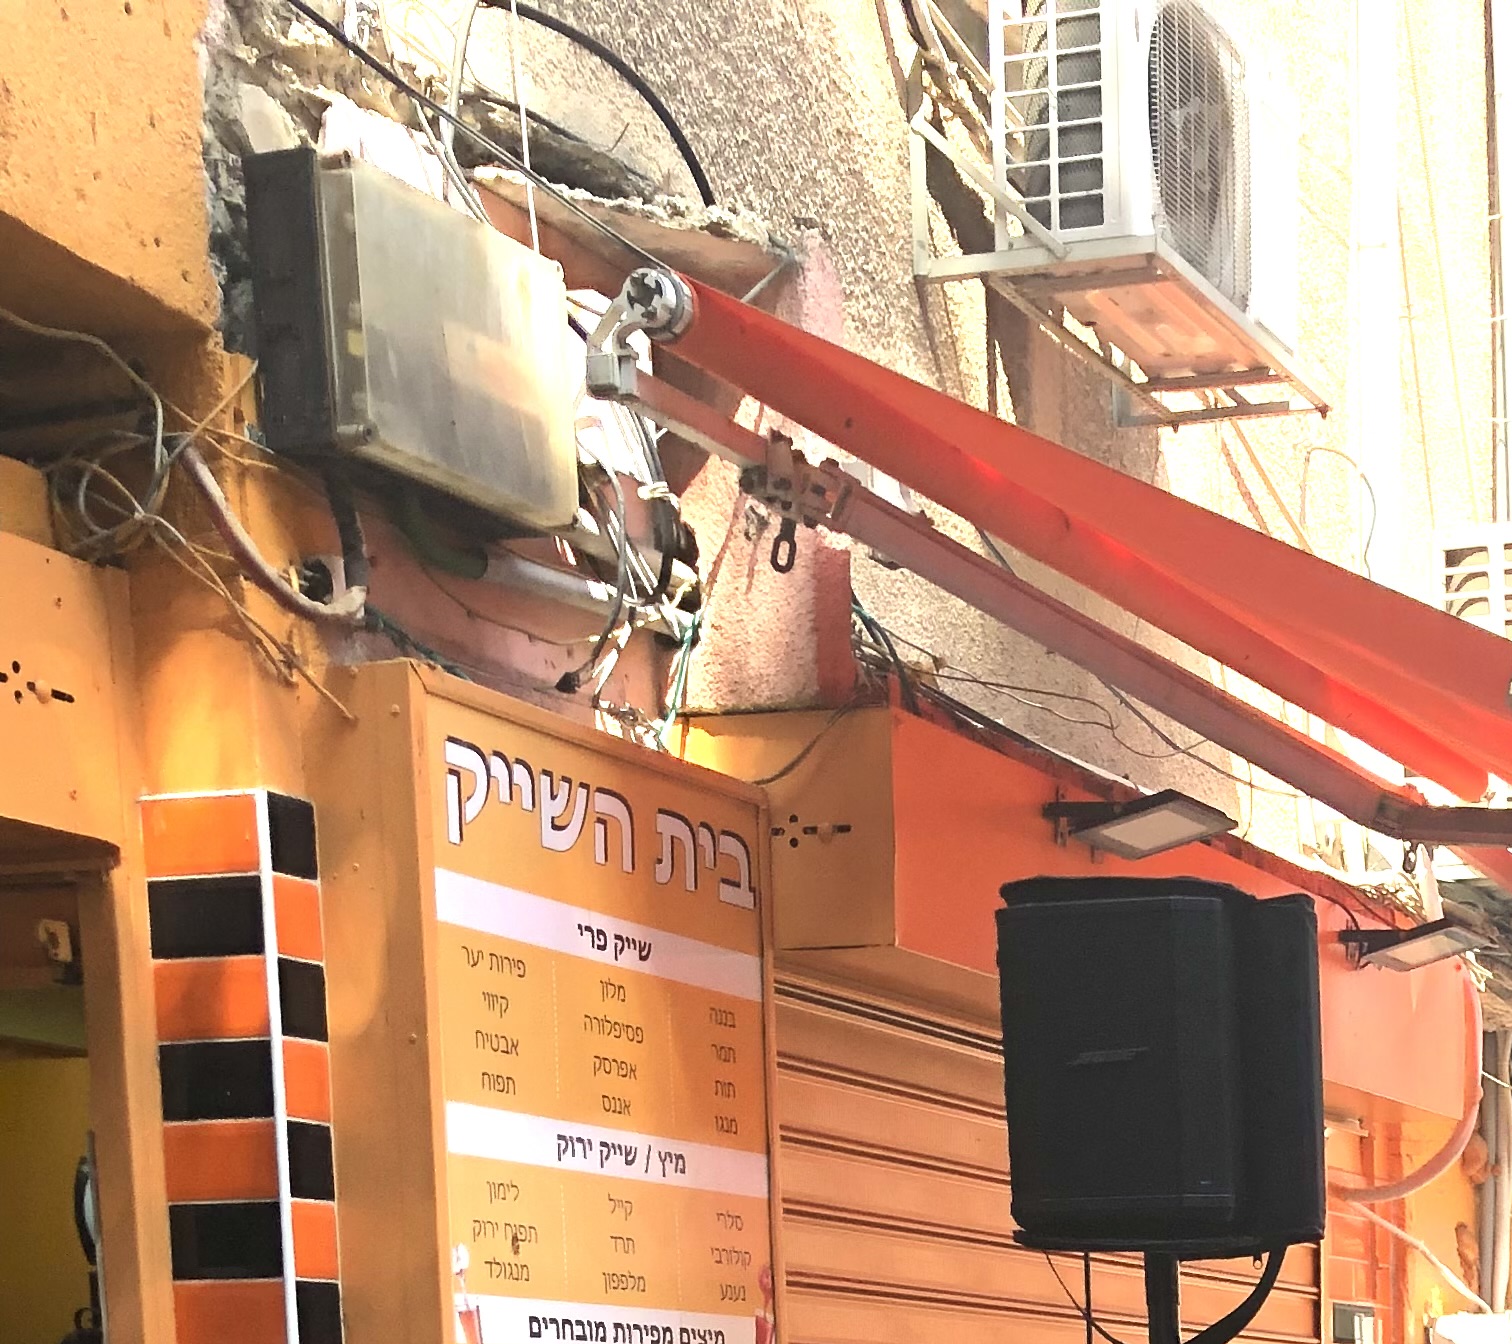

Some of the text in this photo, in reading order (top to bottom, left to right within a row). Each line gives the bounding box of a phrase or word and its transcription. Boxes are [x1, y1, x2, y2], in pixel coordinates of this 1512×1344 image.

[444, 735, 755, 909] בית השייק
[578, 923, 651, 961] שייק פרי
[461, 946, 526, 978] פירות יער
[600, 978, 626, 1002] מלון
[482, 991, 509, 1018] קיווי
[583, 1014, 644, 1044] פסיפלורה
[709, 1007, 736, 1028] בננה
[475, 1029, 519, 1056] אבטיח
[710, 1043, 736, 1063] תמר
[593, 1055, 637, 1081] אפרסק
[481, 1071, 516, 1095] תפוח
[715, 1079, 736, 1098] תות
[601, 1094, 631, 1116] אננס
[715, 1115, 738, 1135] מנגו
[556, 1133, 686, 1177] מיץ / שייק ירוק
[486, 1179, 520, 1204] לימון
[607, 1193, 633, 1221] קייל
[472, 1219, 538, 1244] תפוח ירוק
[716, 1211, 744, 1231] סלרי
[610, 1234, 635, 1254] תרד
[484, 1257, 530, 1282] מנגולד
[711, 1245, 751, 1269] קולורבי
[602, 1270, 646, 1294] מלפפון
[720, 1284, 746, 1302] נענע
[528, 1315, 607, 1343] מובחרים
